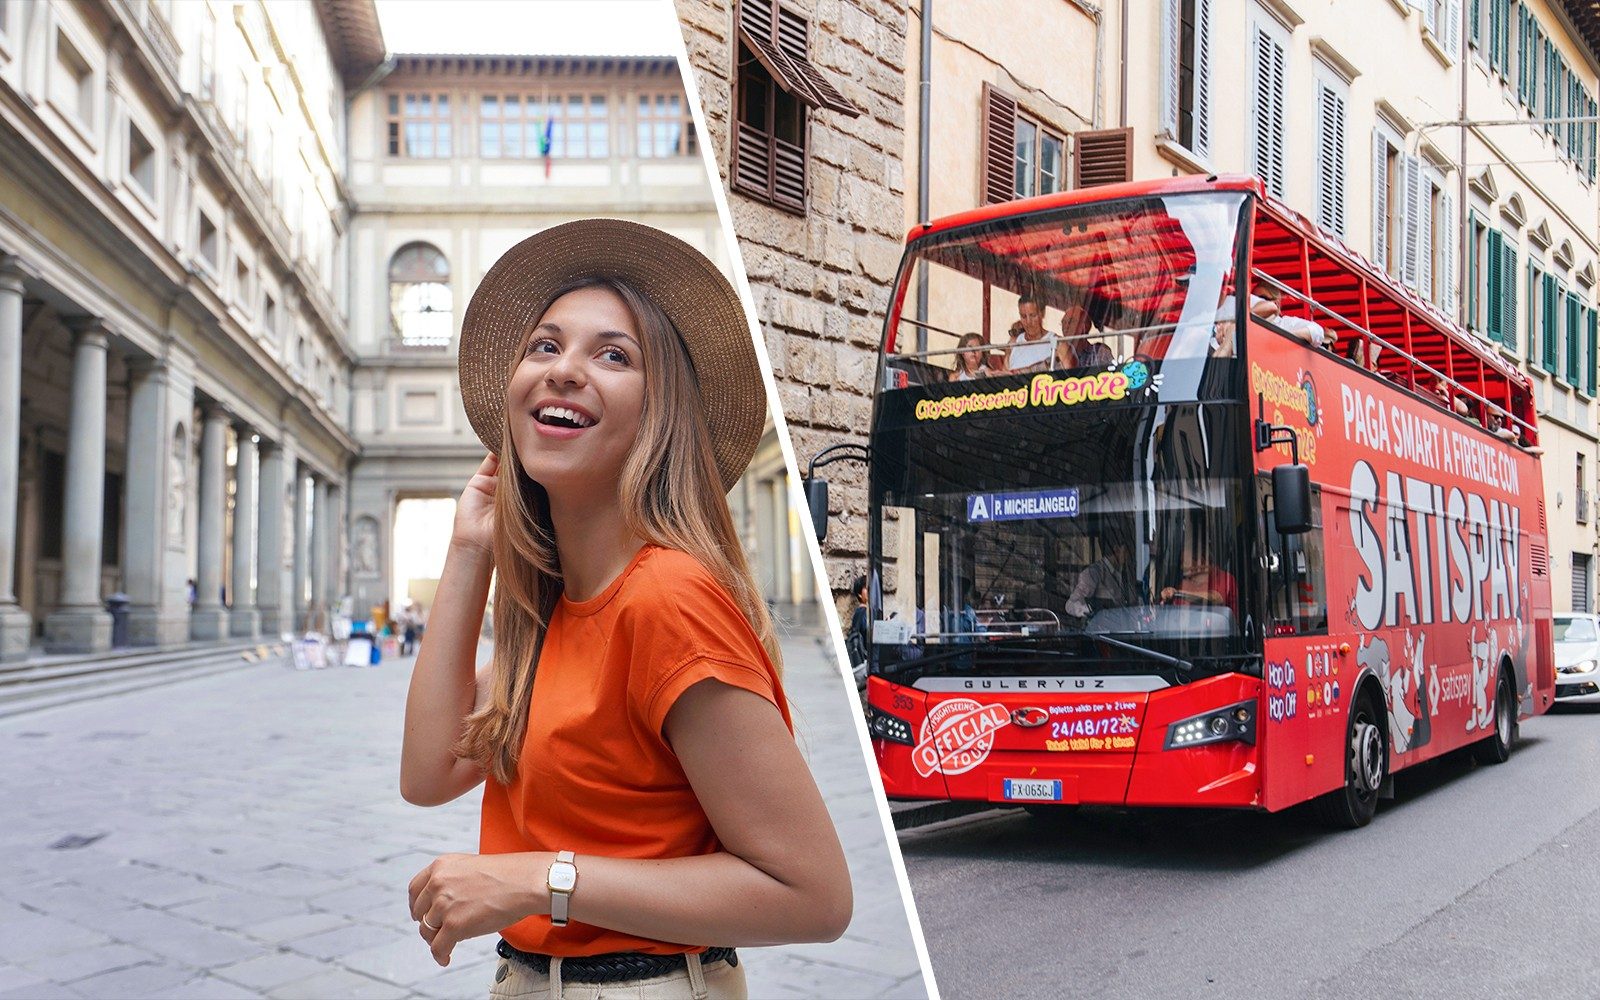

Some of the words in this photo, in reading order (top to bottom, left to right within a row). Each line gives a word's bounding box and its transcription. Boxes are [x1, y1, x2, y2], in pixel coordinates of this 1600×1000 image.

[1341, 383, 1391, 455] PAGA
[1391, 405, 1440, 471] SMART
[1442, 427, 1453, 475] A
[1451, 430, 1499, 488] FIRENZE
[1498, 450, 1519, 496] CON
[971, 495, 989, 519] A
[994, 500, 1002, 516] P.
[1004, 495, 1077, 516] MICHELANGELO
[1349, 459, 1520, 631] SATISPAY
[1268, 664, 1284, 689] Hop
[1284, 659, 1296, 686] On
[1441, 669, 1472, 708] satispay
[1269, 696, 1285, 722] Hop
[1285, 691, 1297, 718] Off
[921, 708, 1005, 767] OFFICIAL
[1051, 717, 1118, 739] 24/48/72
[952, 739, 989, 769] TOUR
